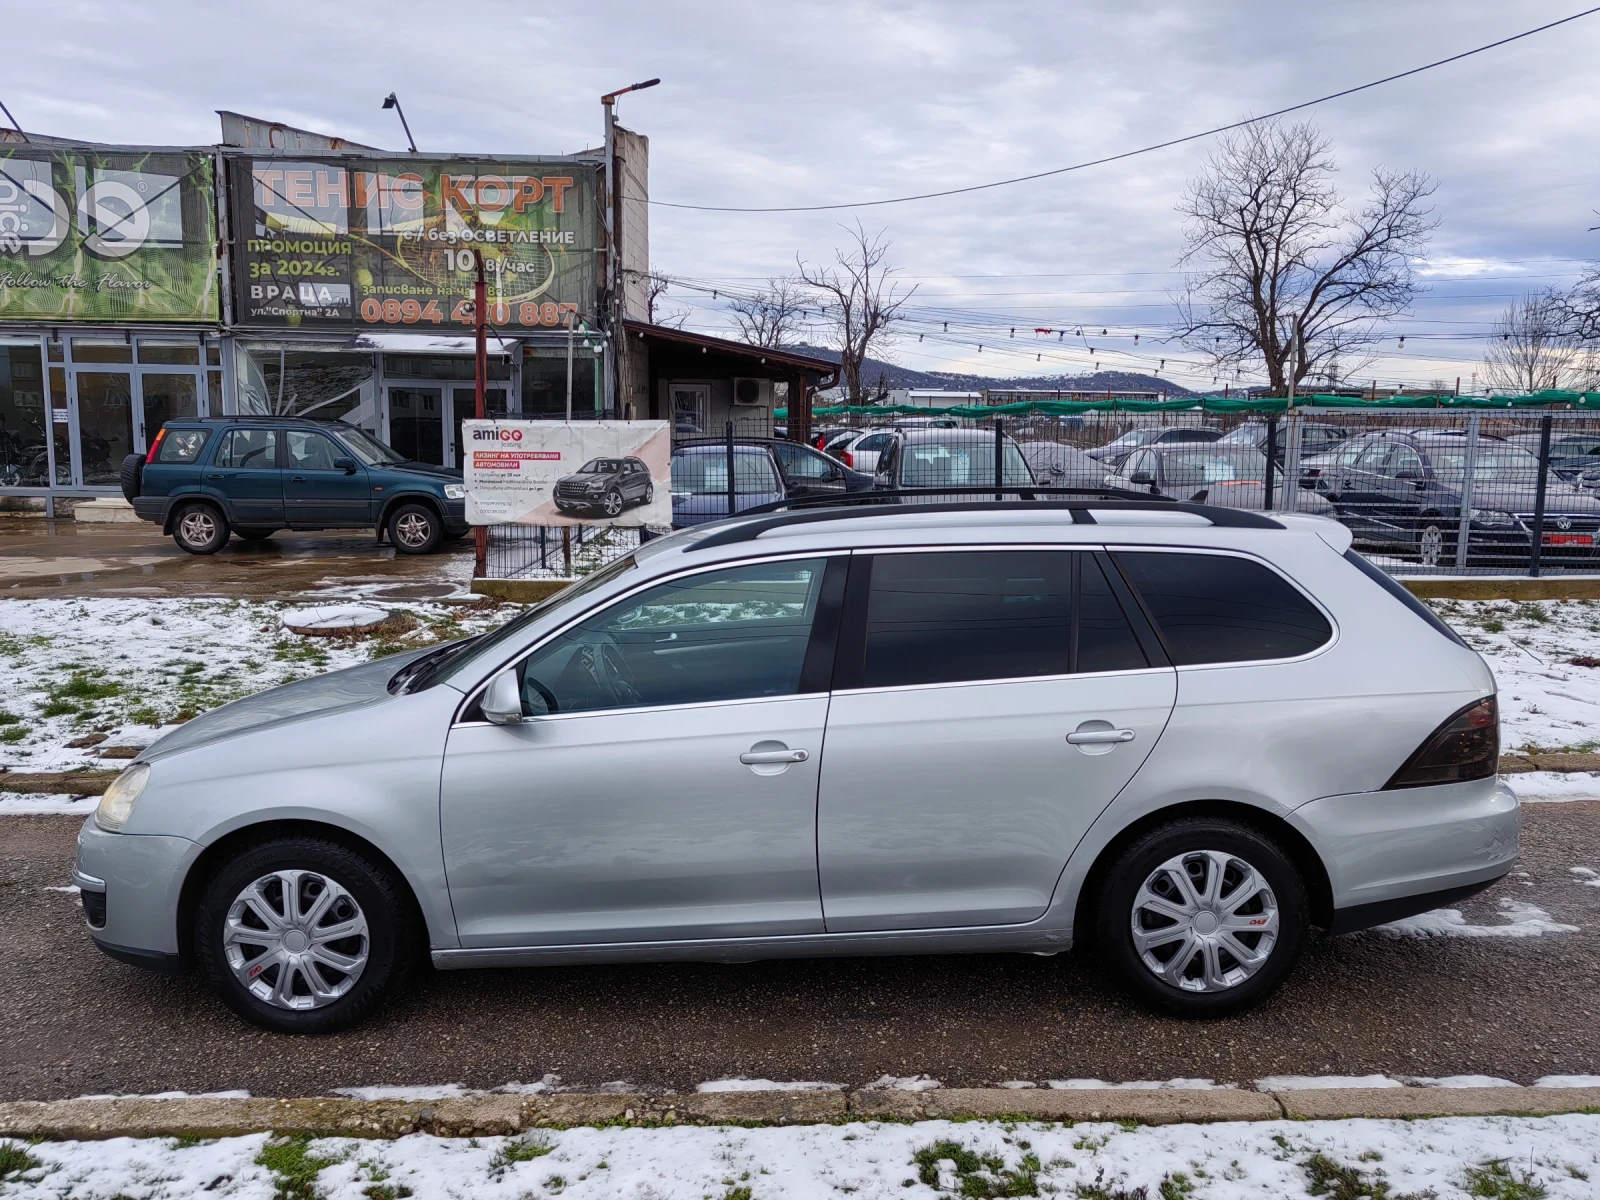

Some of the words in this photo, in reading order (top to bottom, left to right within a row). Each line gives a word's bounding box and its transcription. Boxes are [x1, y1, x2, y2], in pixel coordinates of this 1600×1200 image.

[252, 169, 425, 210] ТЕНИС
[440, 174, 573, 213] КОРТ
[428, 228, 457, 244] без
[461, 229, 575, 244] ОСВЕТЛЕНИЕ
[247, 239, 352, 256] ПРОМОЦИЯ
[249, 262, 271, 278] за
[277, 260, 340, 277] 2024г.
[443, 249, 475, 272] 10
[56, 272, 88, 288] the
[95, 272, 152, 292] Flavor
[362, 284, 433, 296] записване
[437, 288, 453, 296] на
[250, 285, 332, 302] ВРАЦА
[361, 298, 444, 324] 0894
[519, 301, 579, 327] 887
[248, 965, 262, 977] EVO
